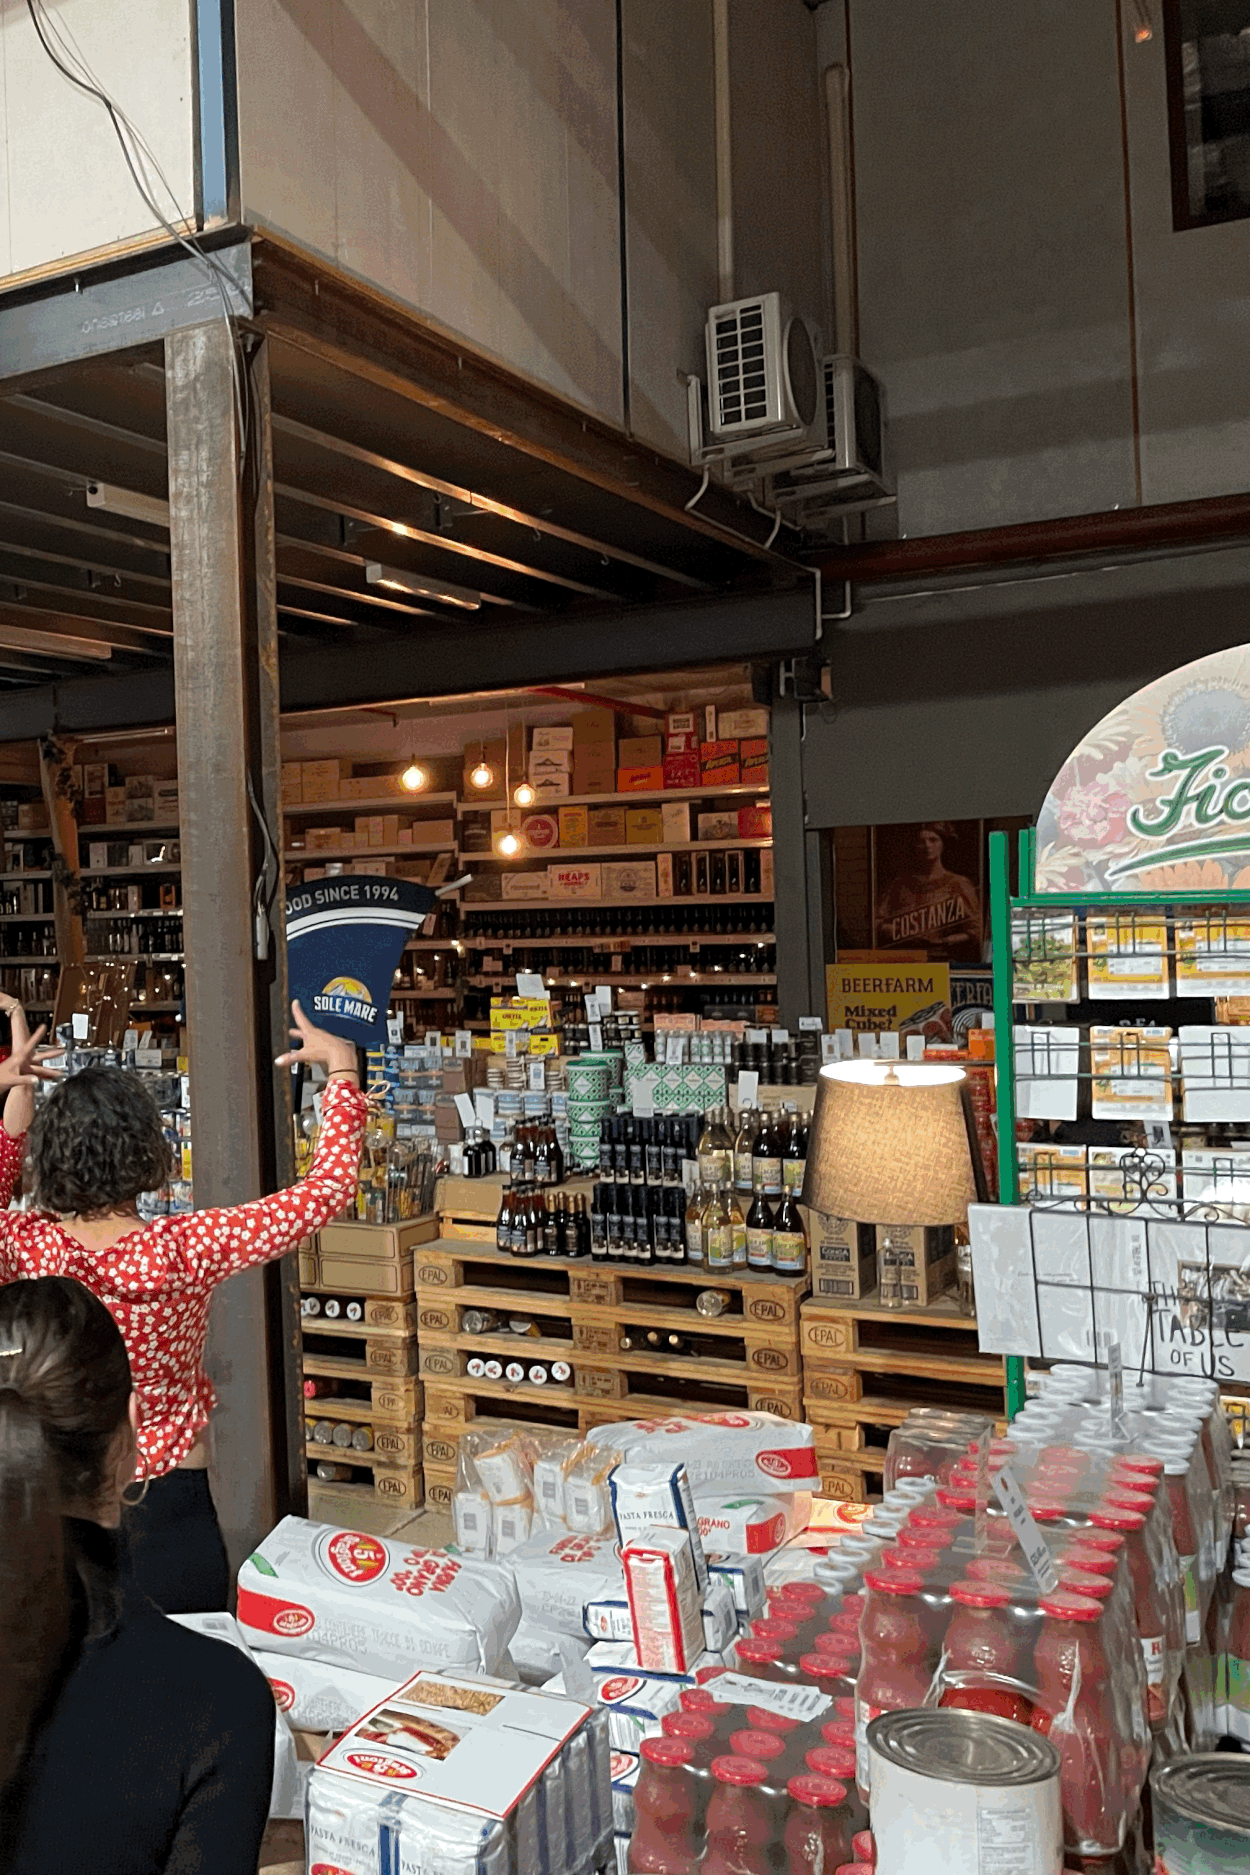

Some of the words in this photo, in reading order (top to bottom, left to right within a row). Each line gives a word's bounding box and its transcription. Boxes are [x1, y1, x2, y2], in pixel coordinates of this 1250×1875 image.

[286, 893, 312, 915] OOD
[314, 885, 359, 905] SINCE
[363, 885, 399, 901] 1994
[892, 896, 966, 941] COSTANZA
[841, 977, 935, 993] BEERFARM
[313, 995, 342, 1014] SOLE
[343, 1000, 378, 1023] MARE
[844, 1004, 898, 1018] Mixed
[844, 1017, 893, 1031] Cube?
[1170, 1348, 1194, 1368] OF
[1200, 1351, 1236, 1379] US
[643, 1511, 674, 1520] FRESCA
